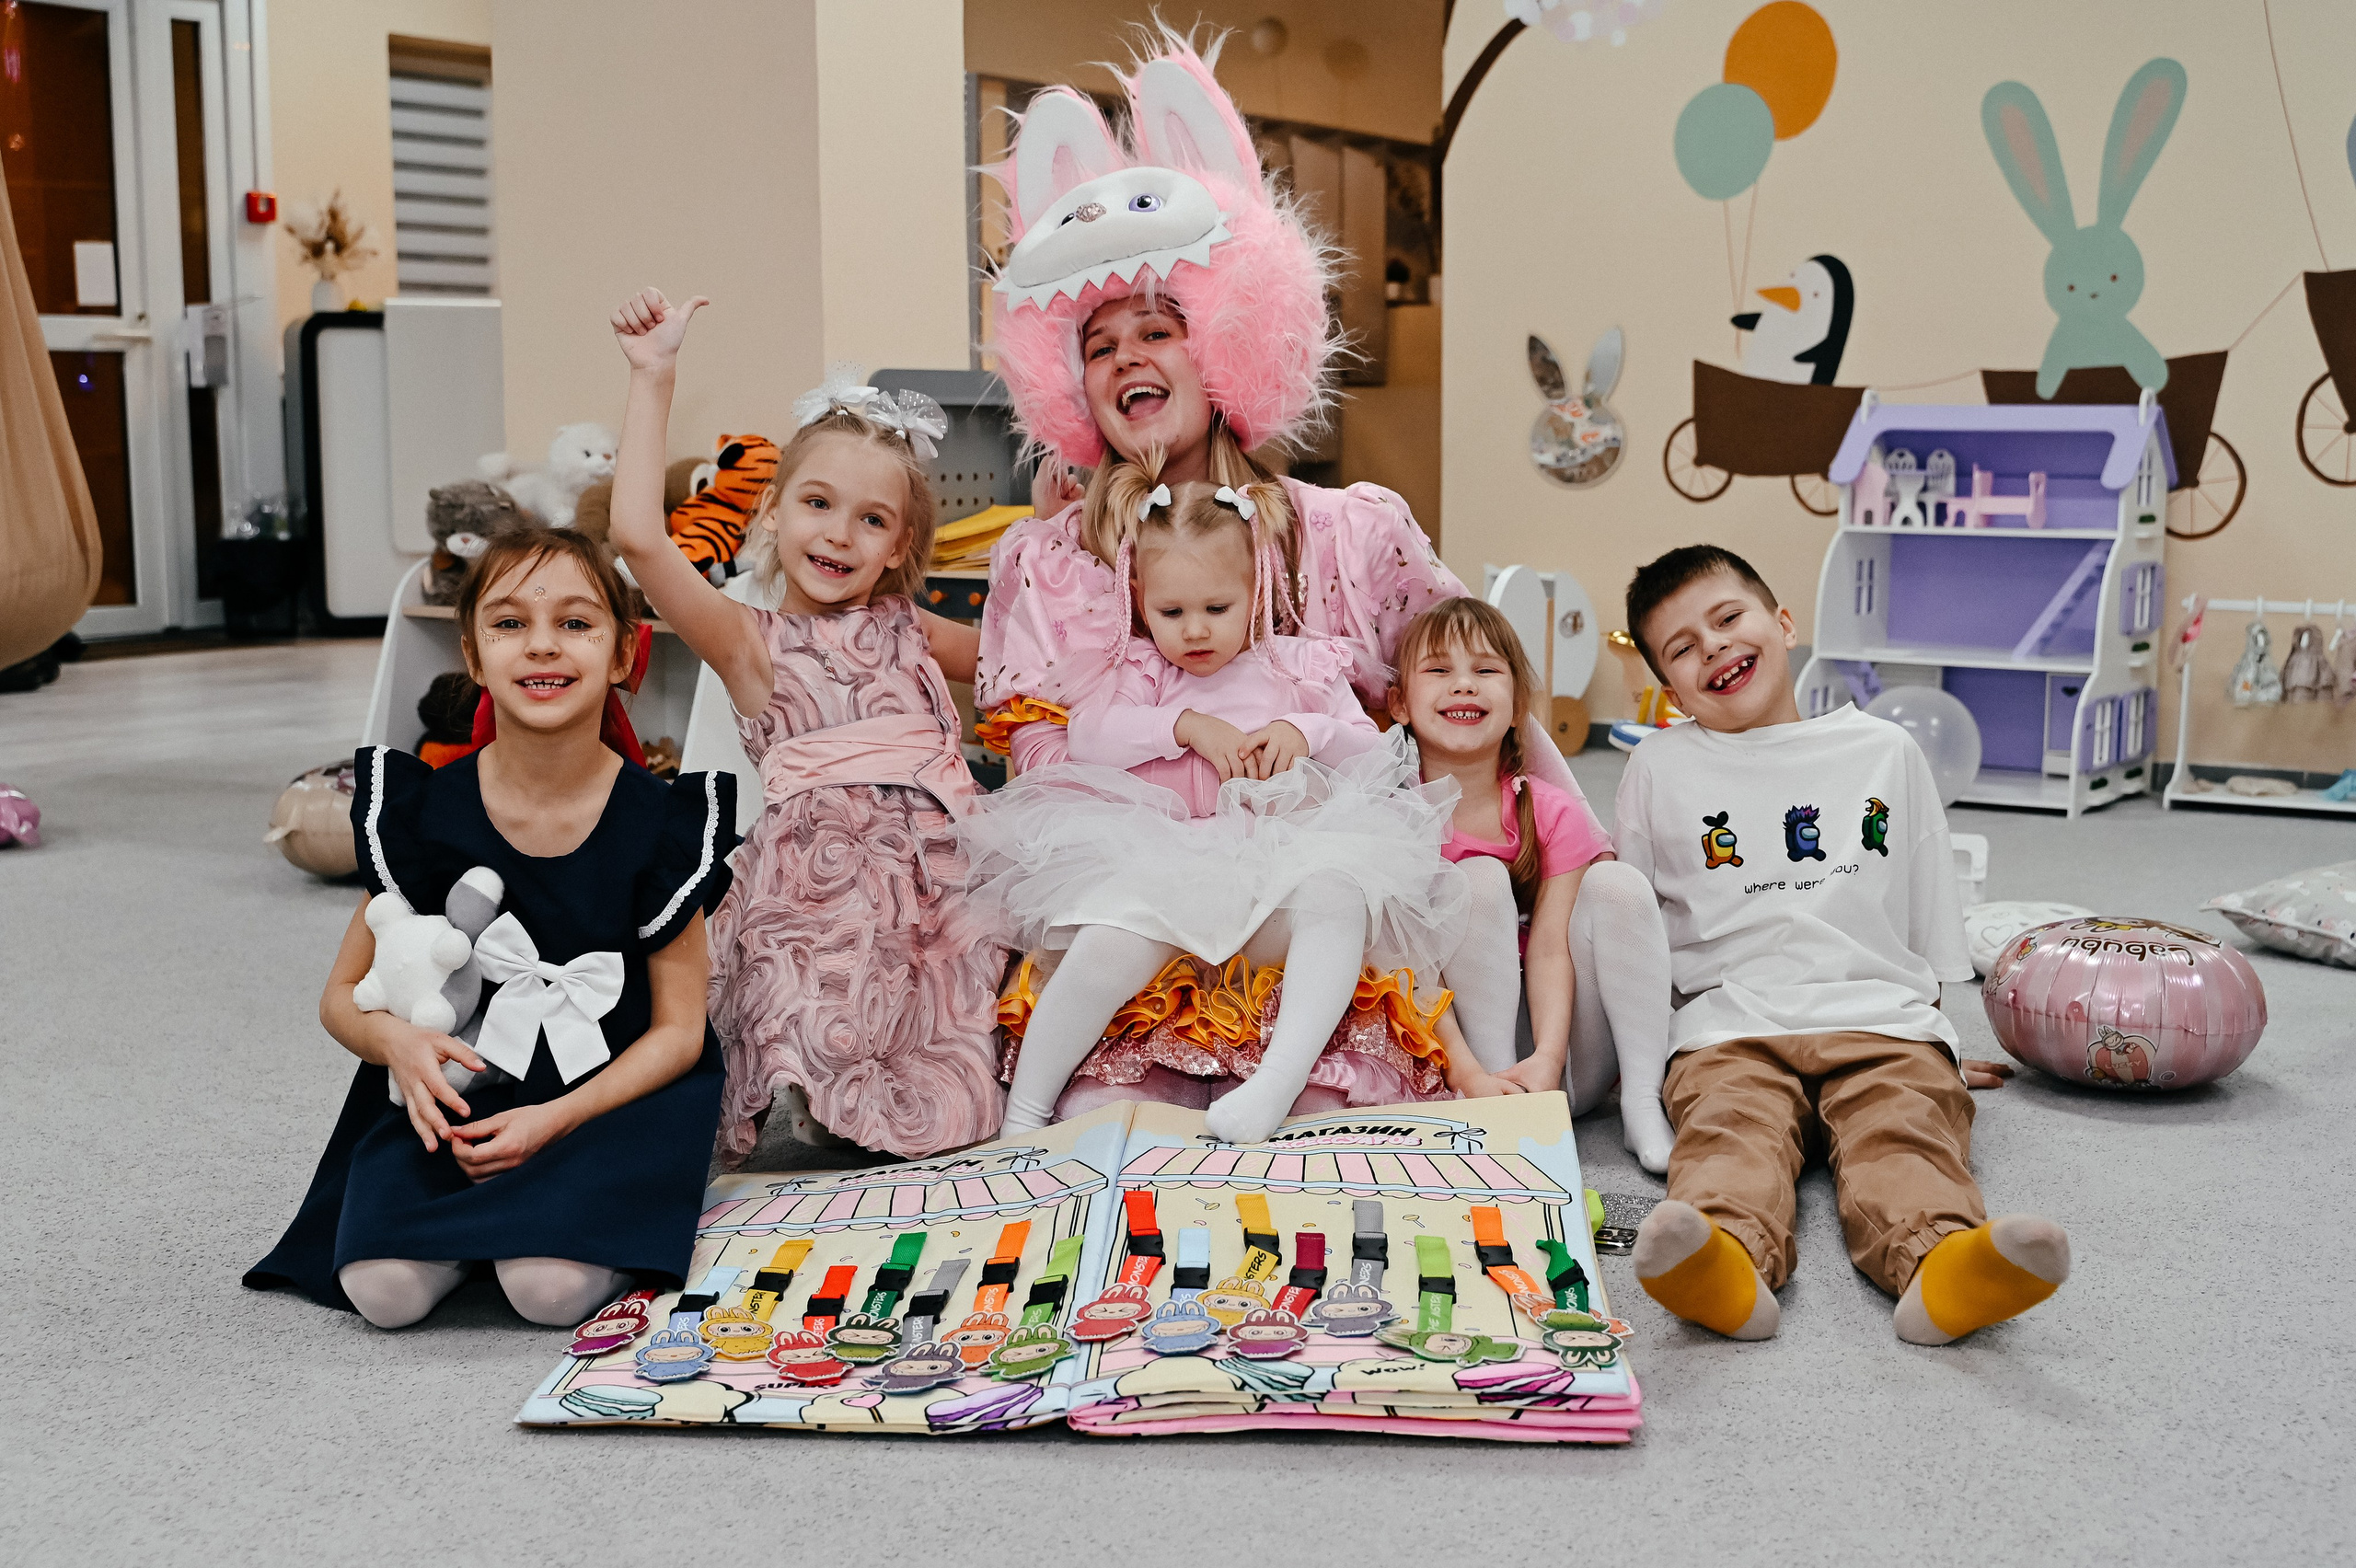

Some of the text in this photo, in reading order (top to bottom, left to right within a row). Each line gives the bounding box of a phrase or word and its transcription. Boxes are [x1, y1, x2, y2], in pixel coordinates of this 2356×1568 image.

[1744, 879, 1787, 894] where
[2060, 937, 2194, 966] Labubu
[1268, 1125, 1416, 1143] МАГАЗИН
[1262, 1136, 1423, 1149] АКСЕССУАРОВ
